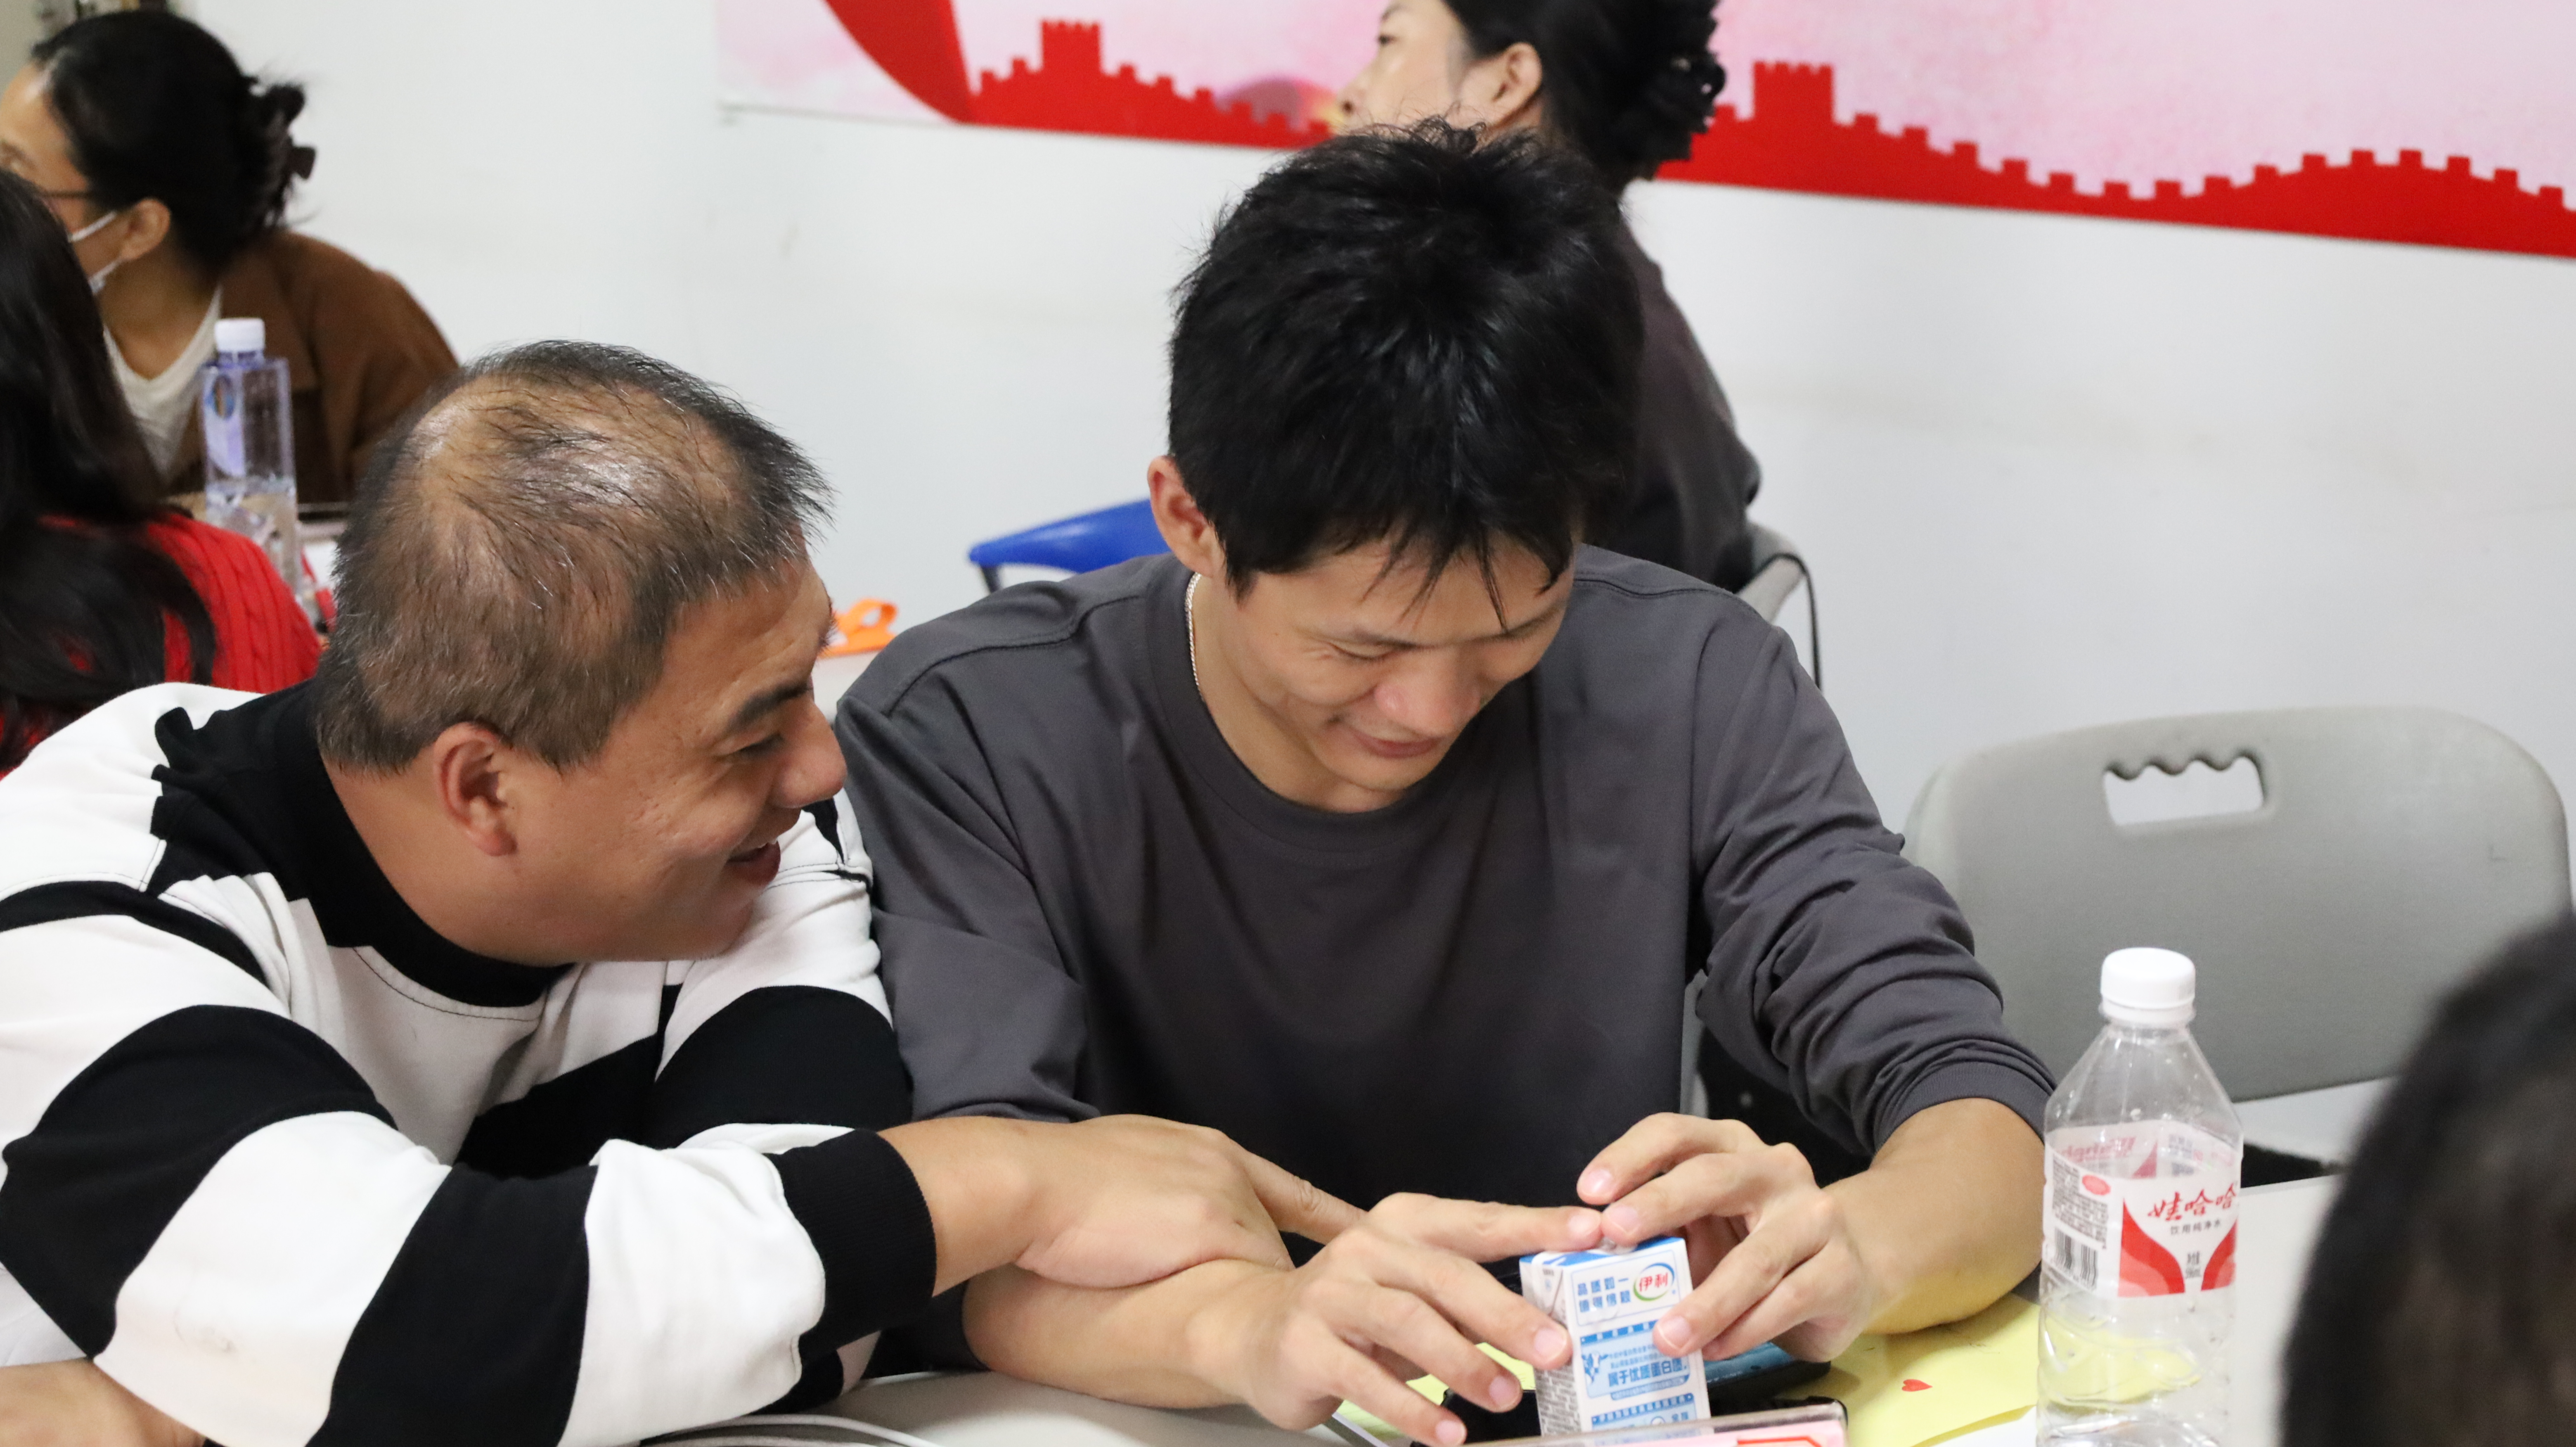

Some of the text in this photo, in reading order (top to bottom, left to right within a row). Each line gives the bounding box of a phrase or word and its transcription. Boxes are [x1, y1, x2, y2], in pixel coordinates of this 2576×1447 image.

[2147, 1183, 2236, 1221] 娃哈哈
[1639, 1272, 1668, 1292] 伊利
